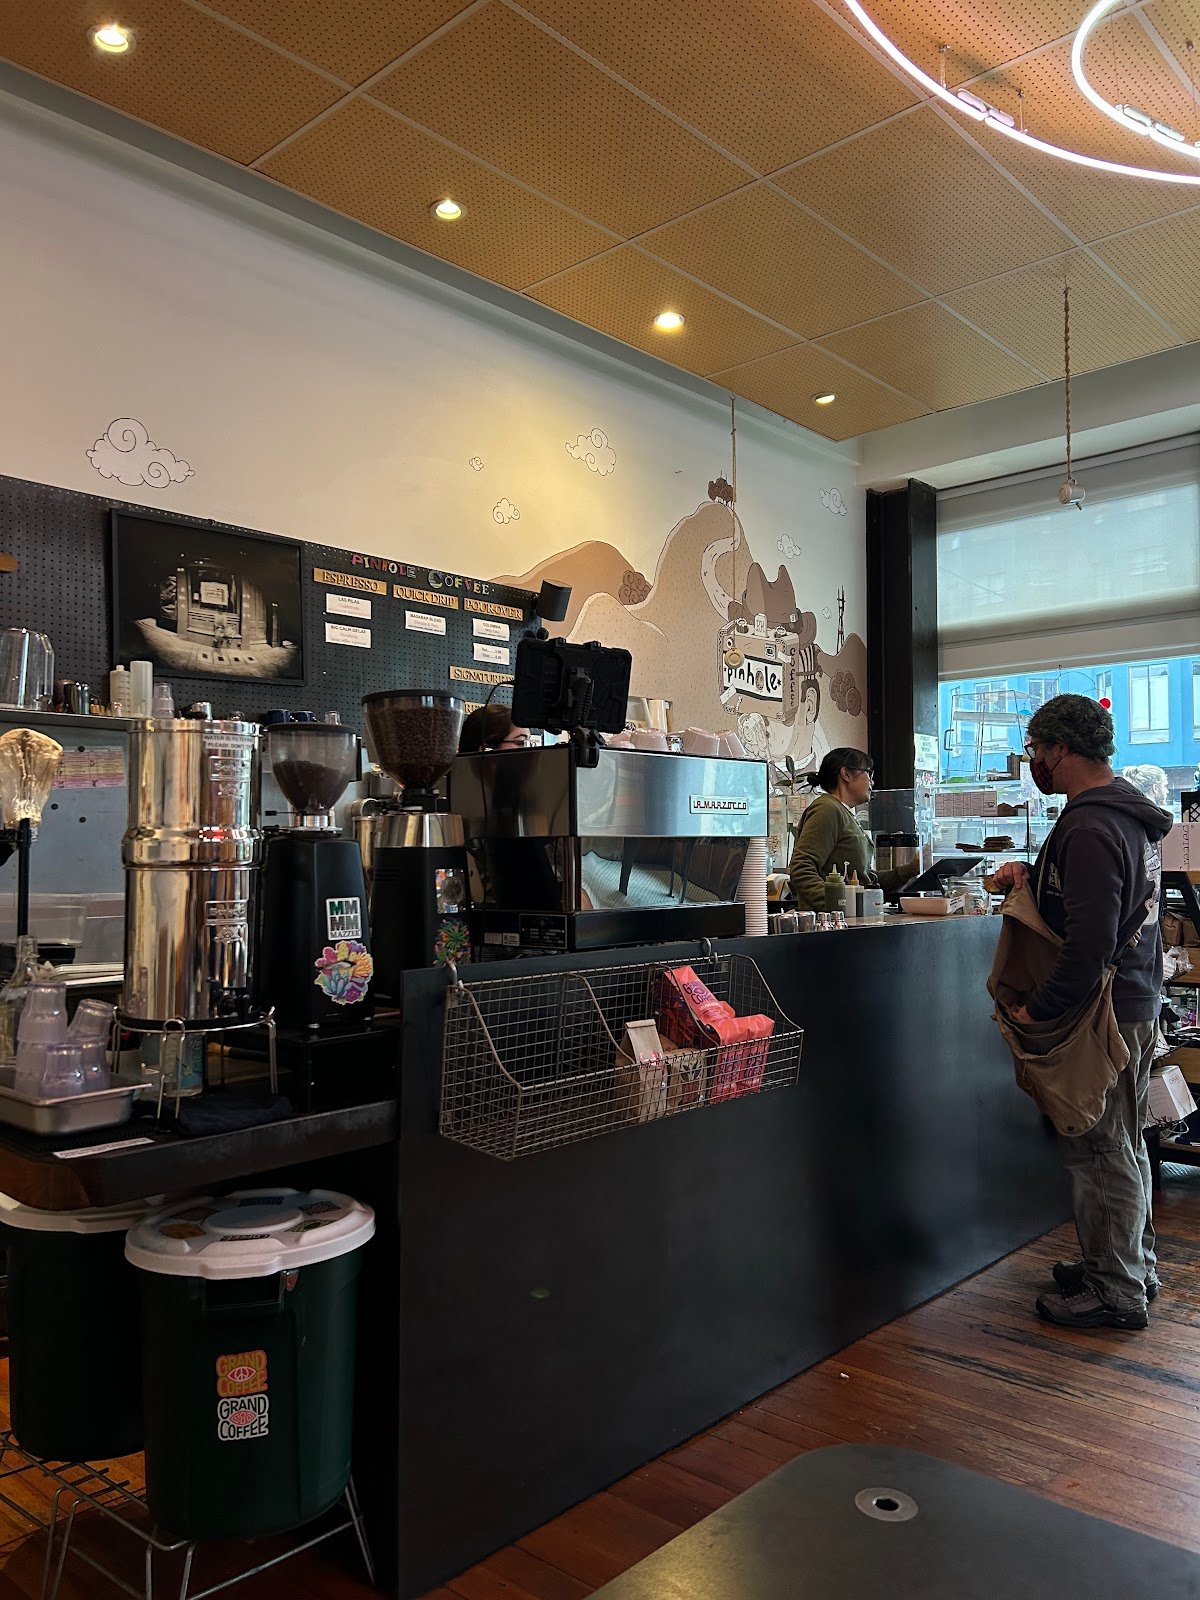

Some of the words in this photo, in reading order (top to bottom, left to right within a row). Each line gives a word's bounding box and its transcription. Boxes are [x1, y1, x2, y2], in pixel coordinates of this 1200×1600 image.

[323, 571, 380, 591] ESPRESSO
[352, 554, 416, 578] PINHOLE
[428, 570, 490, 595] COFFEE
[397, 587, 430, 602] QUICK
[432, 593, 456, 606] DRIP
[728, 662, 777, 693] pinhole
[219, 1351, 266, 1375] GRAND
[218, 1371, 267, 1395] COFFEE
[219, 1396, 267, 1420] GRAND
[219, 1415, 267, 1439] COFFEE
